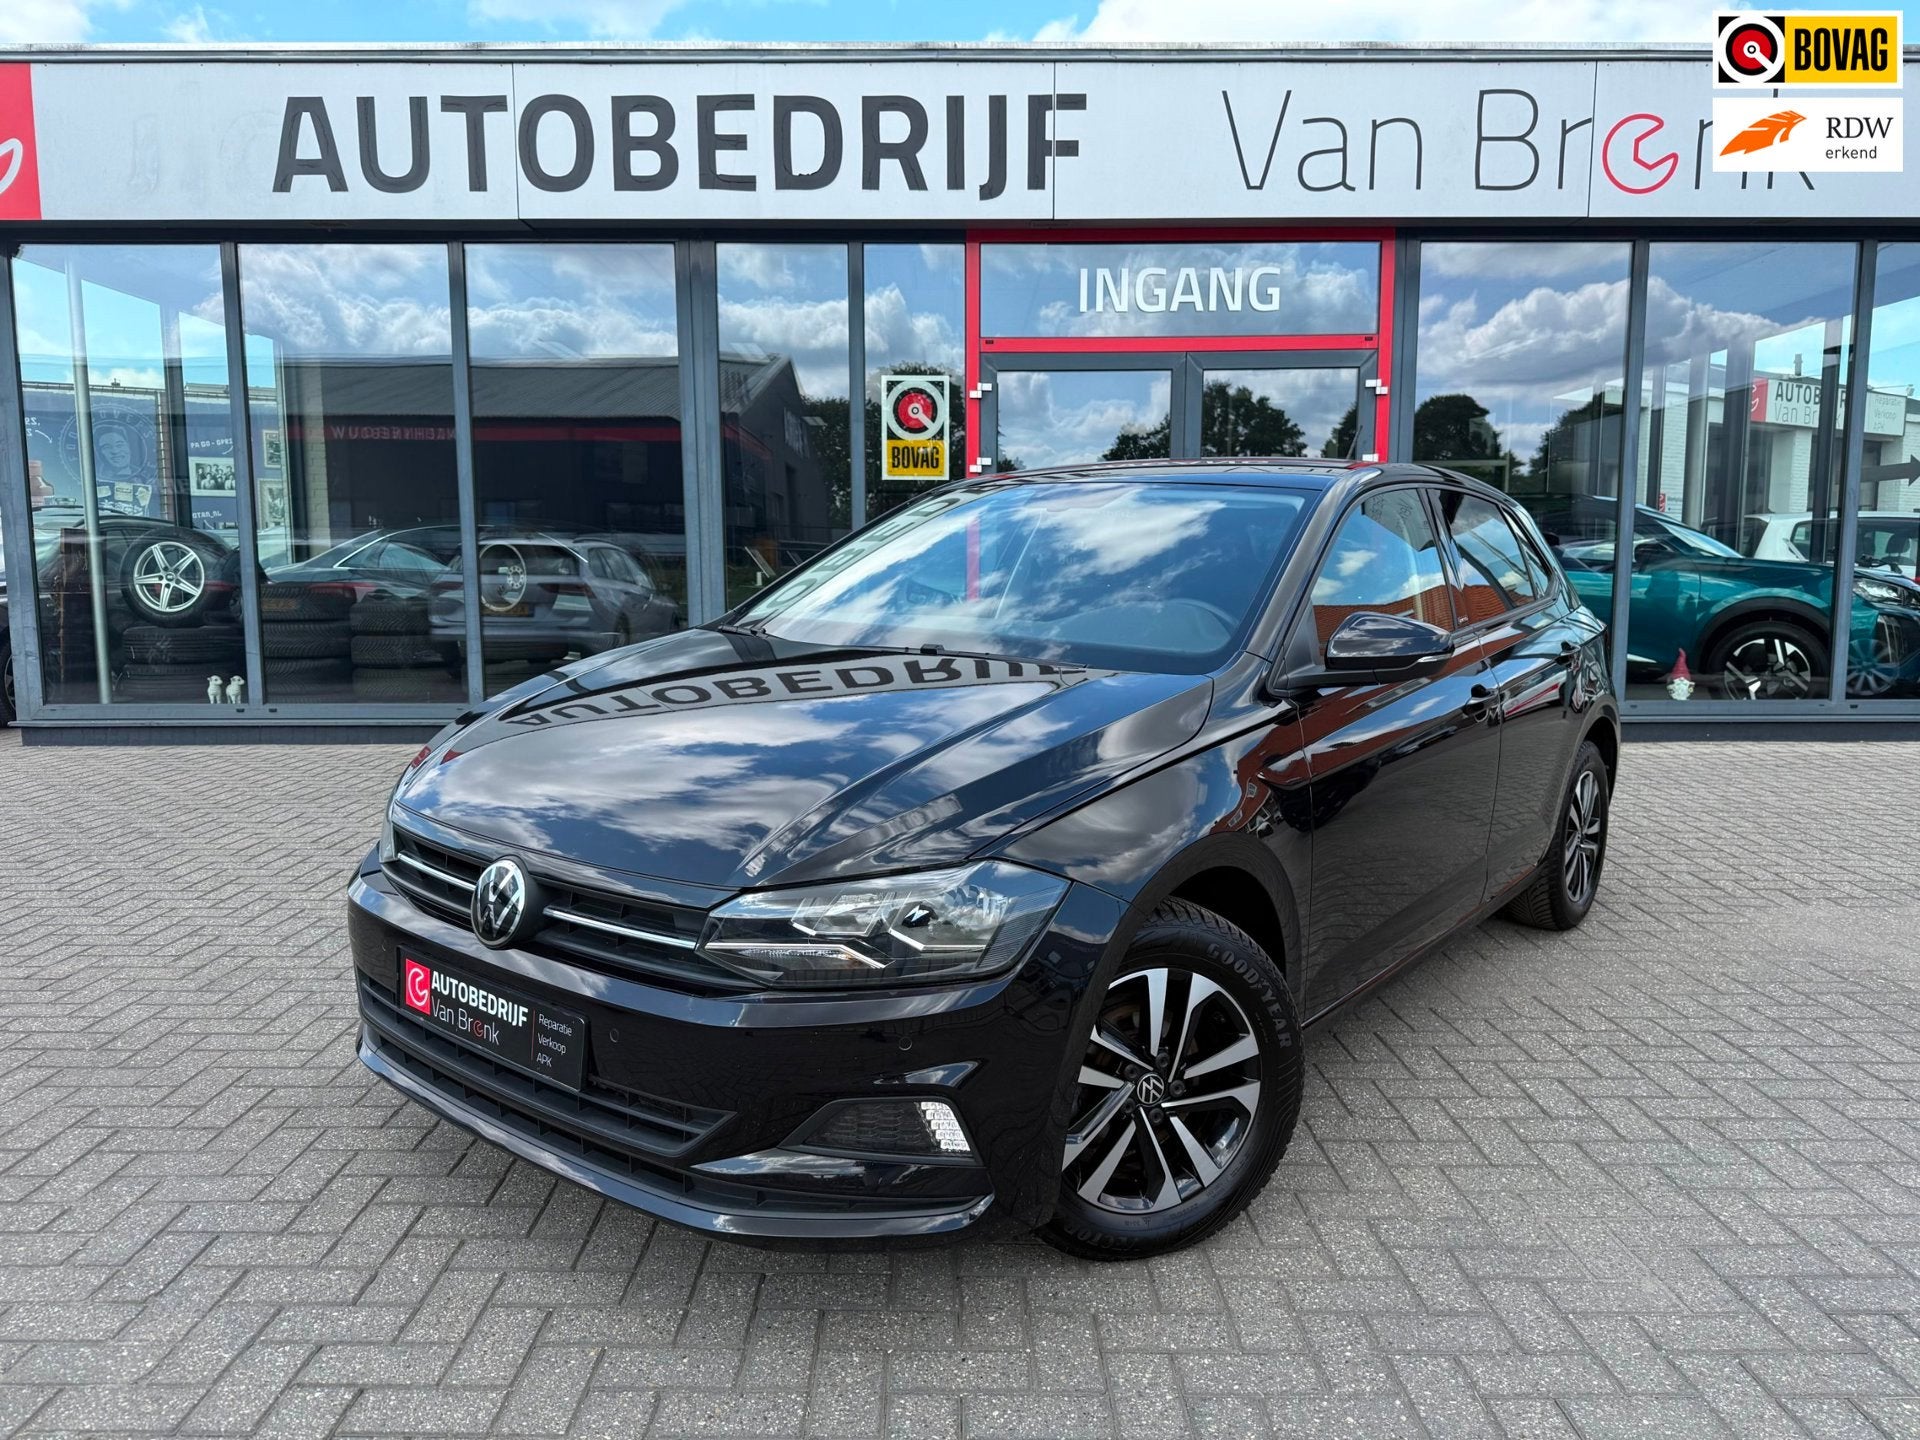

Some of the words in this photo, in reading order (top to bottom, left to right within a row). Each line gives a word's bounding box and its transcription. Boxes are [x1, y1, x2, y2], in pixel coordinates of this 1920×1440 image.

[272, 93, 1087, 200] AUTOBEDRIJF
[1222, 89, 1356, 192] Van
[1079, 266, 1281, 312] INGANG
[1774, 403, 1798, 423] Van
[891, 446, 940, 469] BOVAG
[431, 970, 529, 1027] AUTOBEDRIJF
[1206, 943, 1292, 1048] GOODYEAR
[431, 996, 455, 1026] Van
[538, 1013, 573, 1037] Reparatie
[537, 1032, 567, 1056] Verkoop
[536, 1051, 552, 1068] APK
